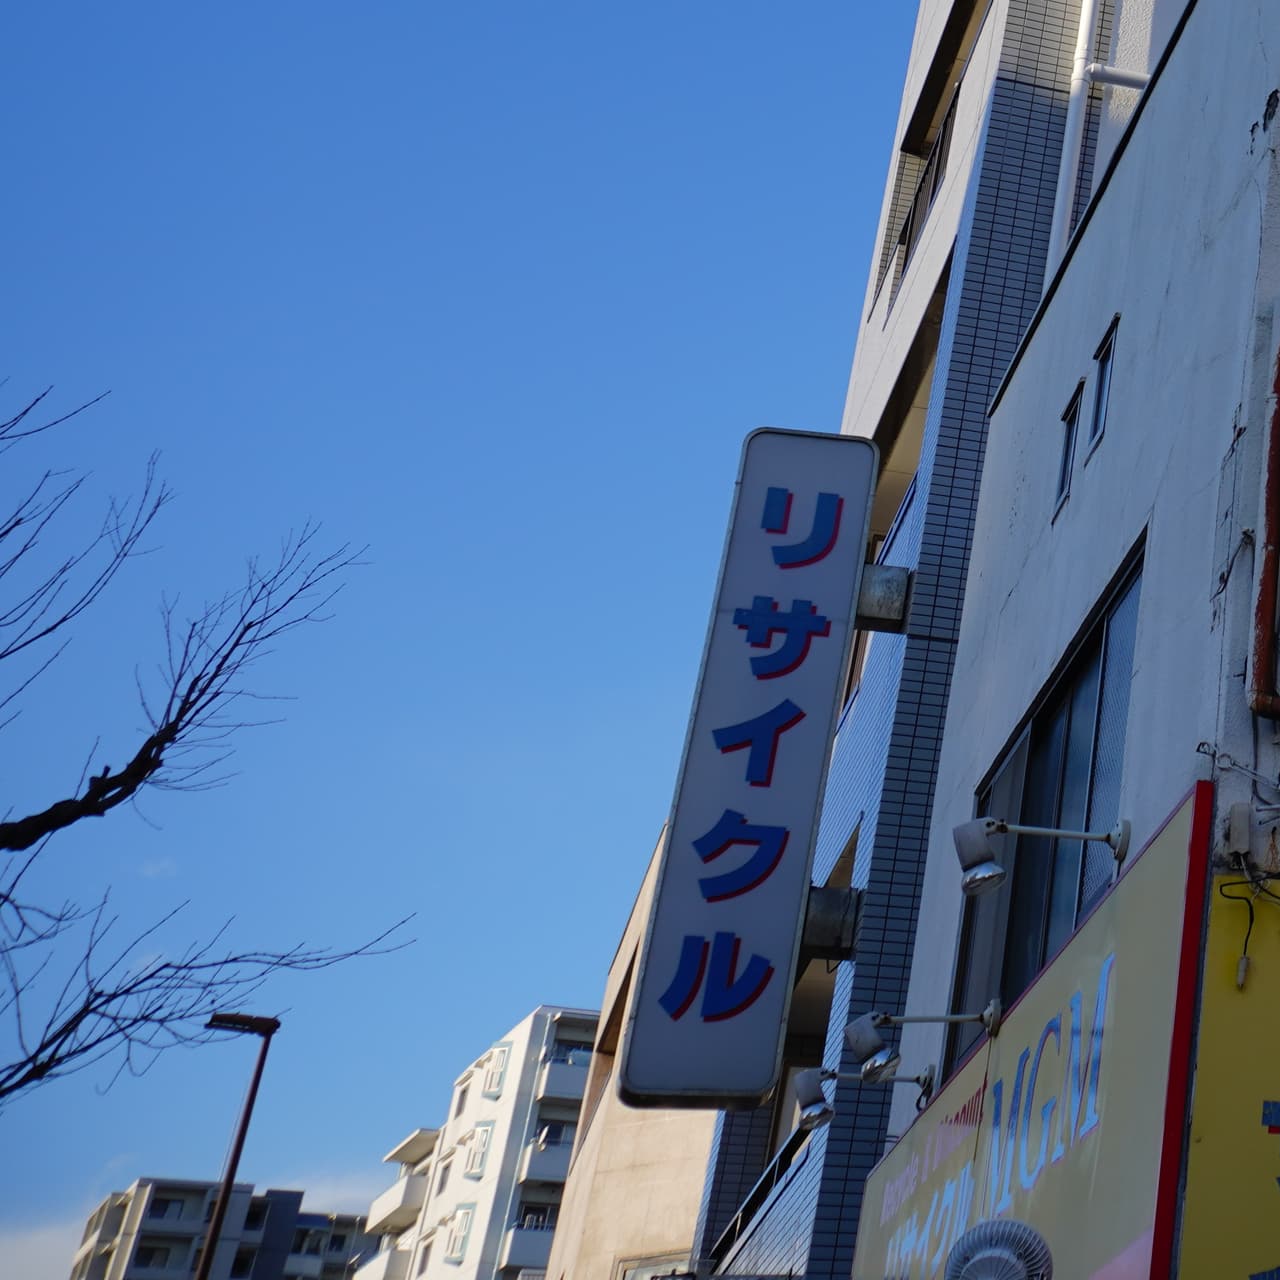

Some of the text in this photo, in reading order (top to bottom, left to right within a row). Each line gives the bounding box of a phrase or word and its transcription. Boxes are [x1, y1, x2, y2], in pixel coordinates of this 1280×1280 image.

[658, 487, 844, 1021] リサイクル
[980, 951, 1116, 1220] MGM
